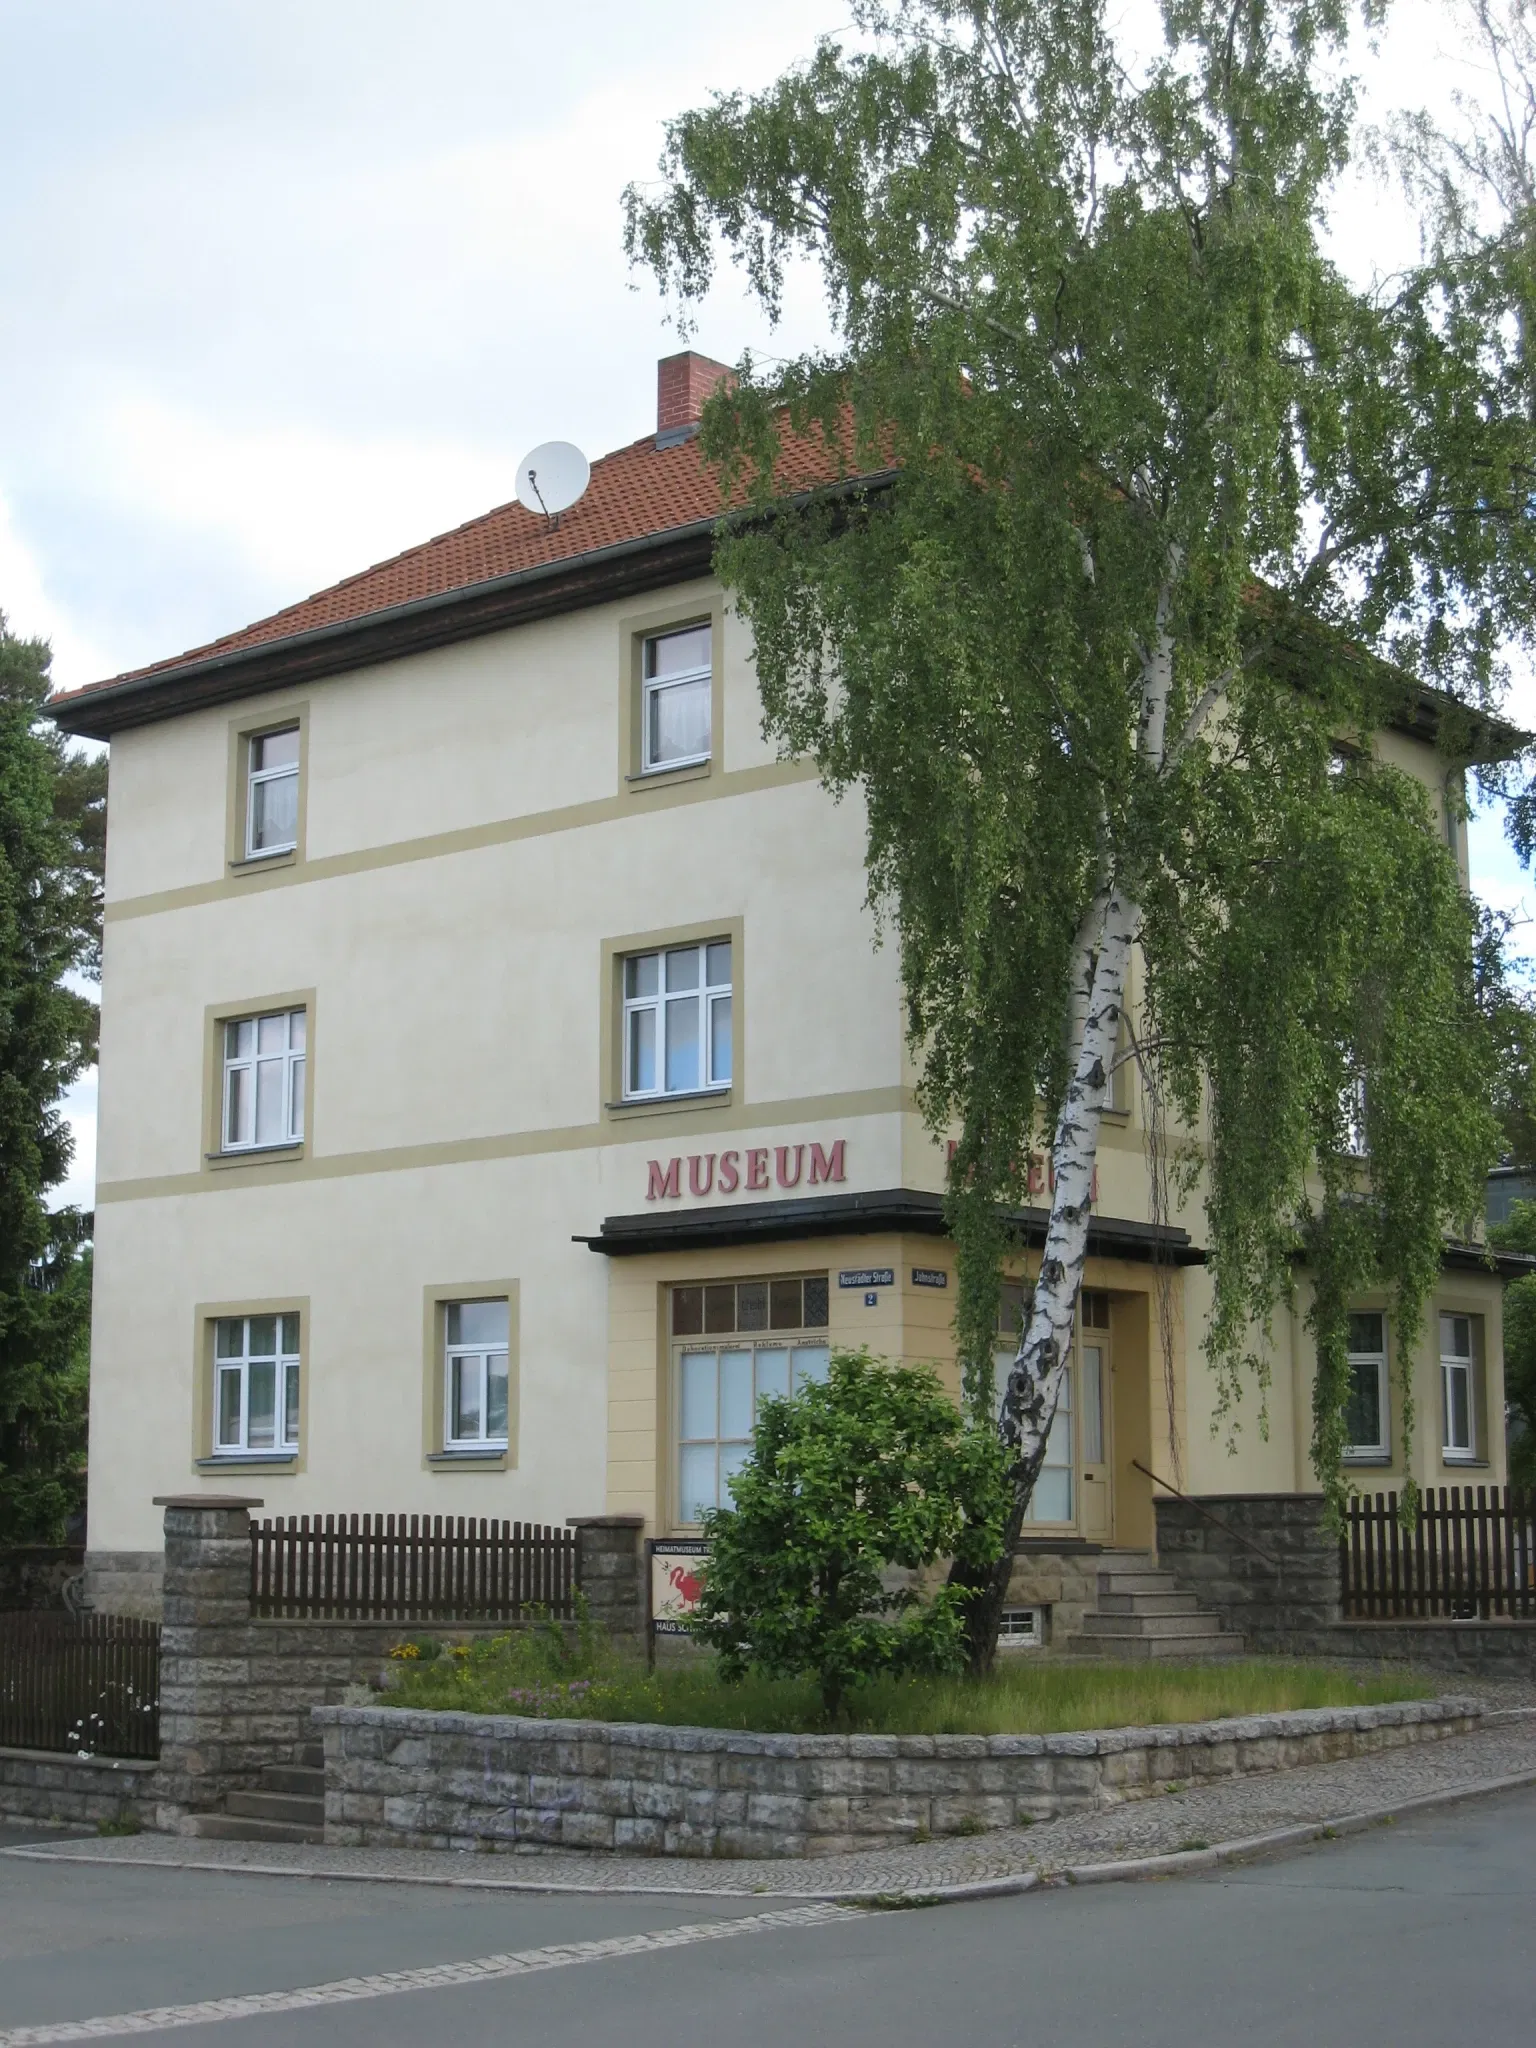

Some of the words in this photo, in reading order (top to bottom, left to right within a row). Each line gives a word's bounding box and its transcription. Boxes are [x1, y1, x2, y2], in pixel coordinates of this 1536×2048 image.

[646, 1140, 847, 1201] MUSEUM
[840, 1273, 872, 1285] Neustädter
[873, 1271, 892, 1284] Straße
[867, 1293, 874, 1305] 2
[655, 1545, 702, 1554] HEIMATMUSEUM
[656, 1621, 676, 1631] HAUS
